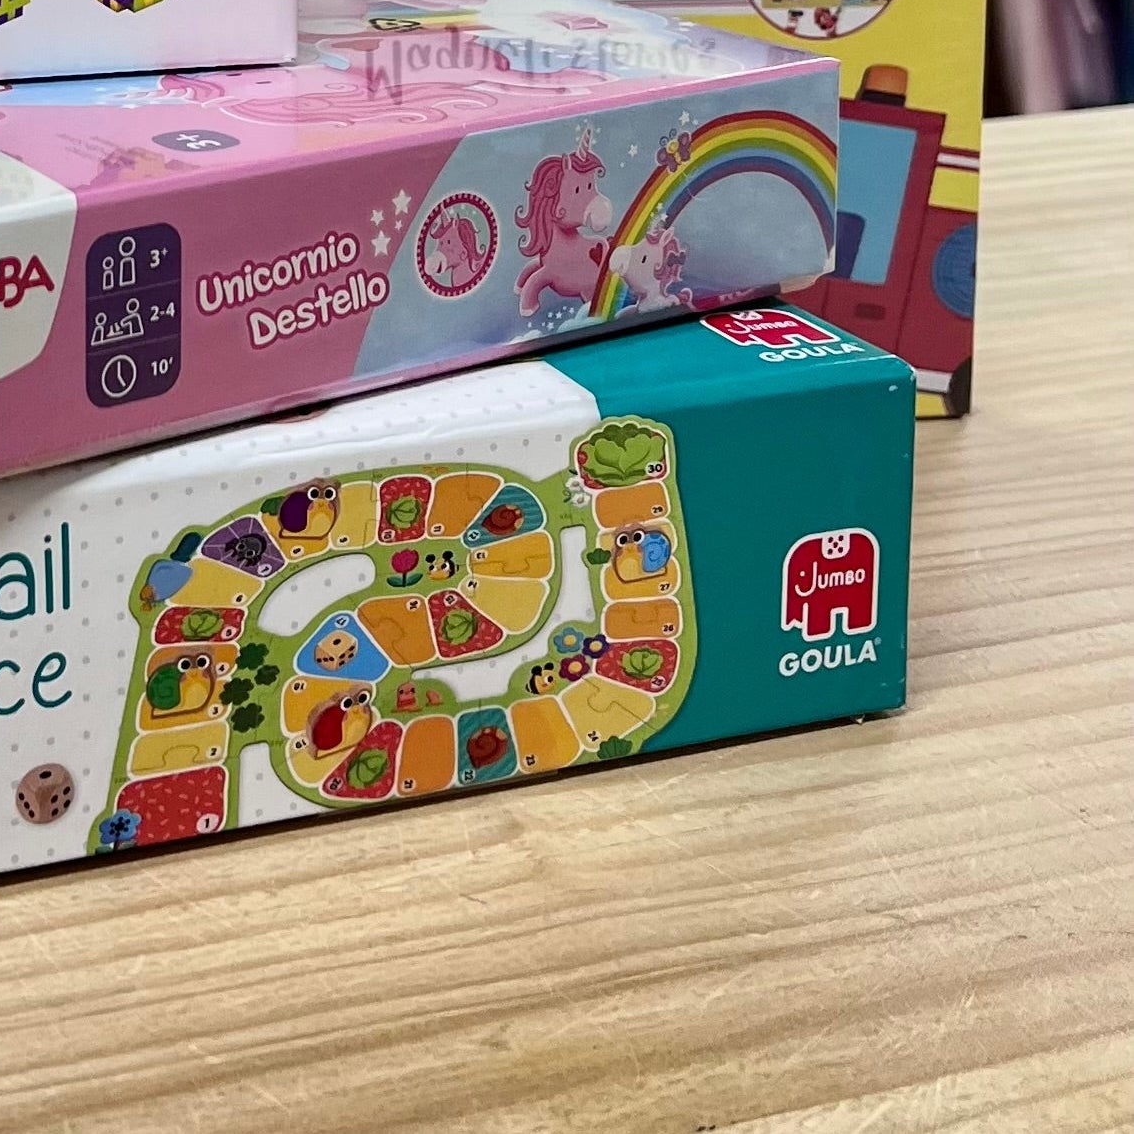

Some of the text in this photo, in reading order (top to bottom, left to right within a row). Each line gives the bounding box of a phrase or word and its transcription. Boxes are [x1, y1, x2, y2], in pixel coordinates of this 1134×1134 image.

[150, 246, 169, 268] 3+
[198, 233, 358, 313] Unicornio
[150, 302, 176, 323] 2-4
[248, 272, 388, 347] Destello
[759, 342, 865, 363] GOULA
[648, 464, 662, 473] 30
[779, 640, 877, 677] GOULA
